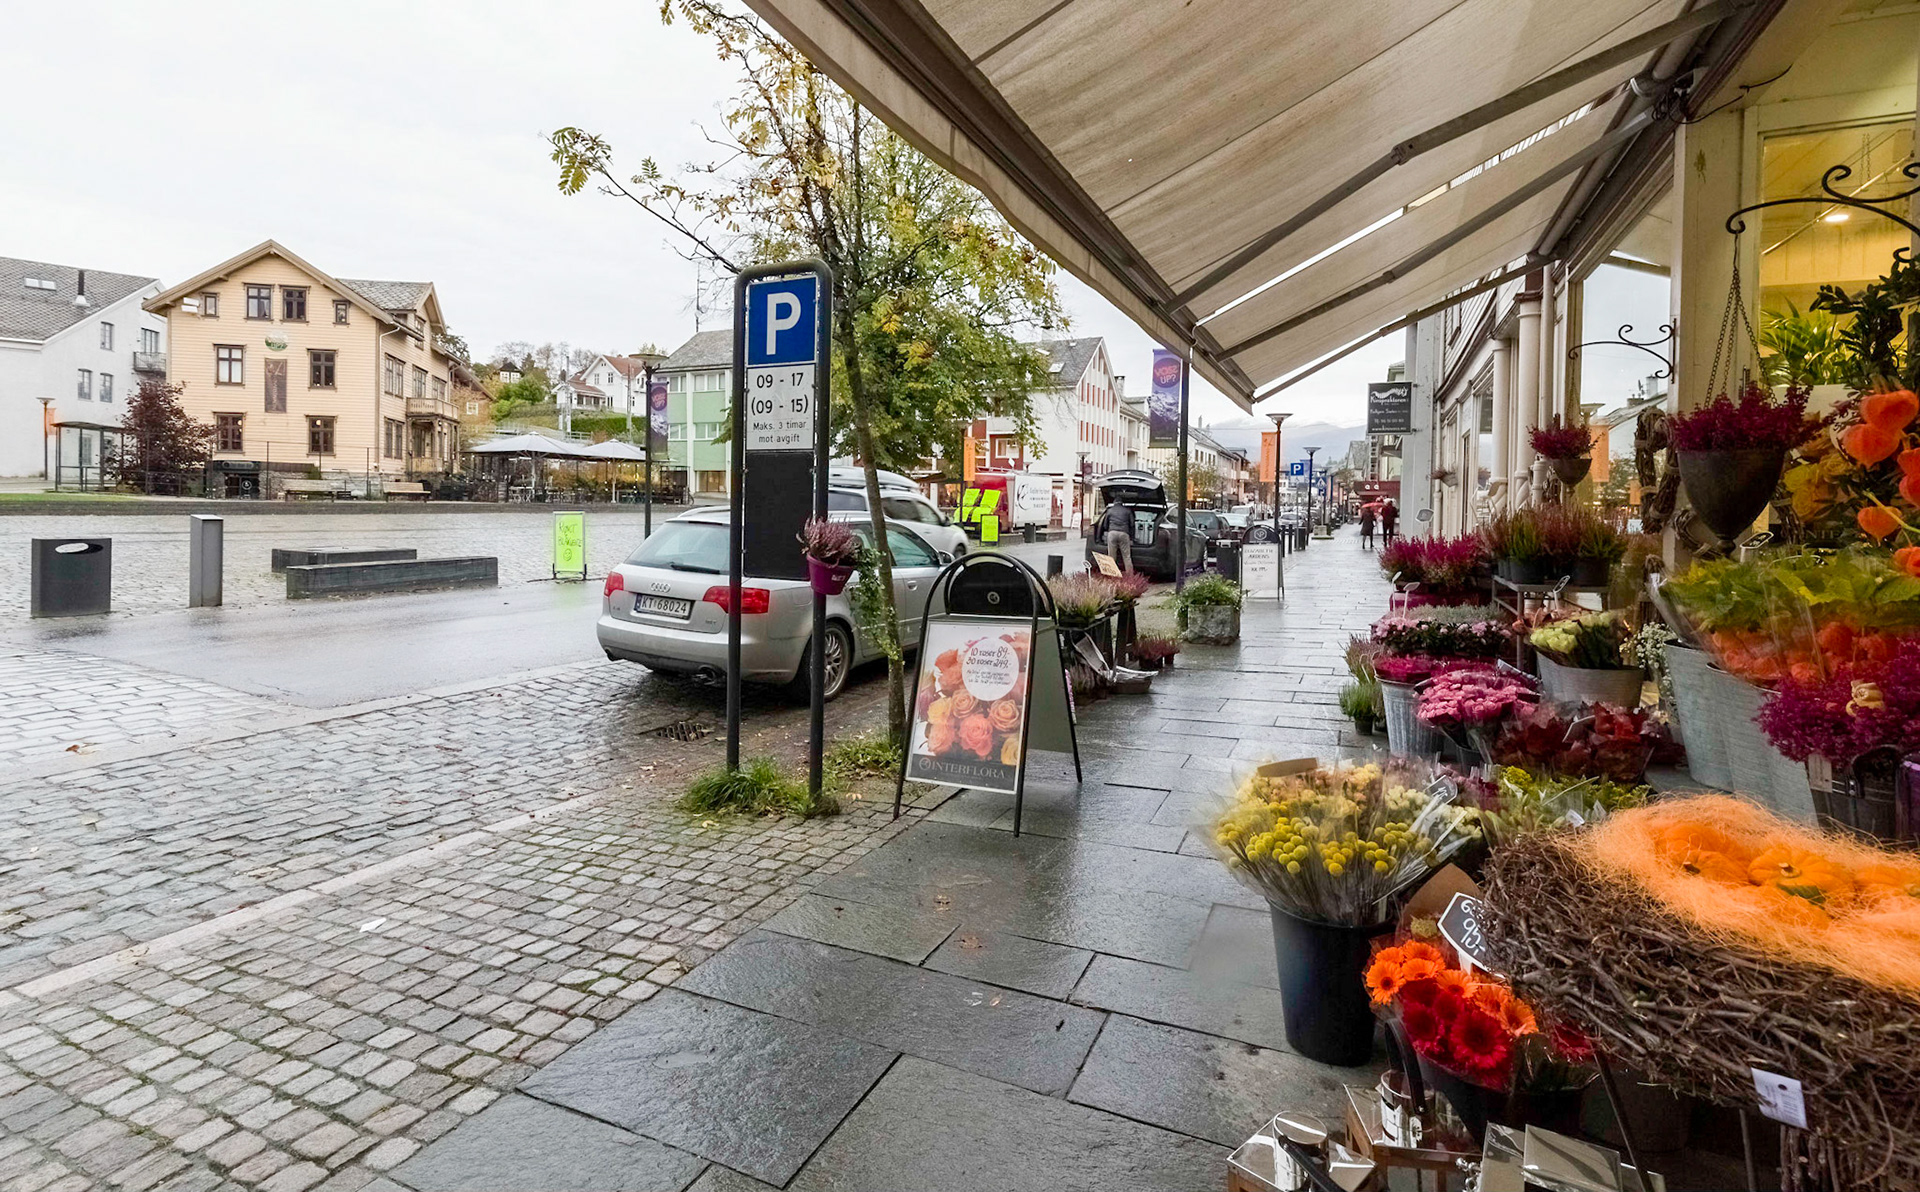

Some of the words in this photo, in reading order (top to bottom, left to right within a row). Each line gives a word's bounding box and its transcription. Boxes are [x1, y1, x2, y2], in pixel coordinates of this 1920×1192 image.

[766, 291, 801, 356] P
[756, 374, 773, 389] 09
[791, 373, 804, 387] 17
[1160, 373, 1177, 384] UP?
[751, 397, 773, 415] (09
[791, 394, 809, 414] 15)
[753, 422, 775, 431] Maks.
[778, 422, 783, 430] 3
[786, 420, 807, 430] timar
[758, 434, 774, 443] mot
[776, 433, 800, 445] avgift
[1293, 464, 1302, 475] P
[642, 595, 654, 609] KT
[658, 599, 687, 614] 68024
[970, 647, 979, 657] 10
[979, 650, 996, 658] roser
[931, 761, 1005, 779] INTERFLORA
